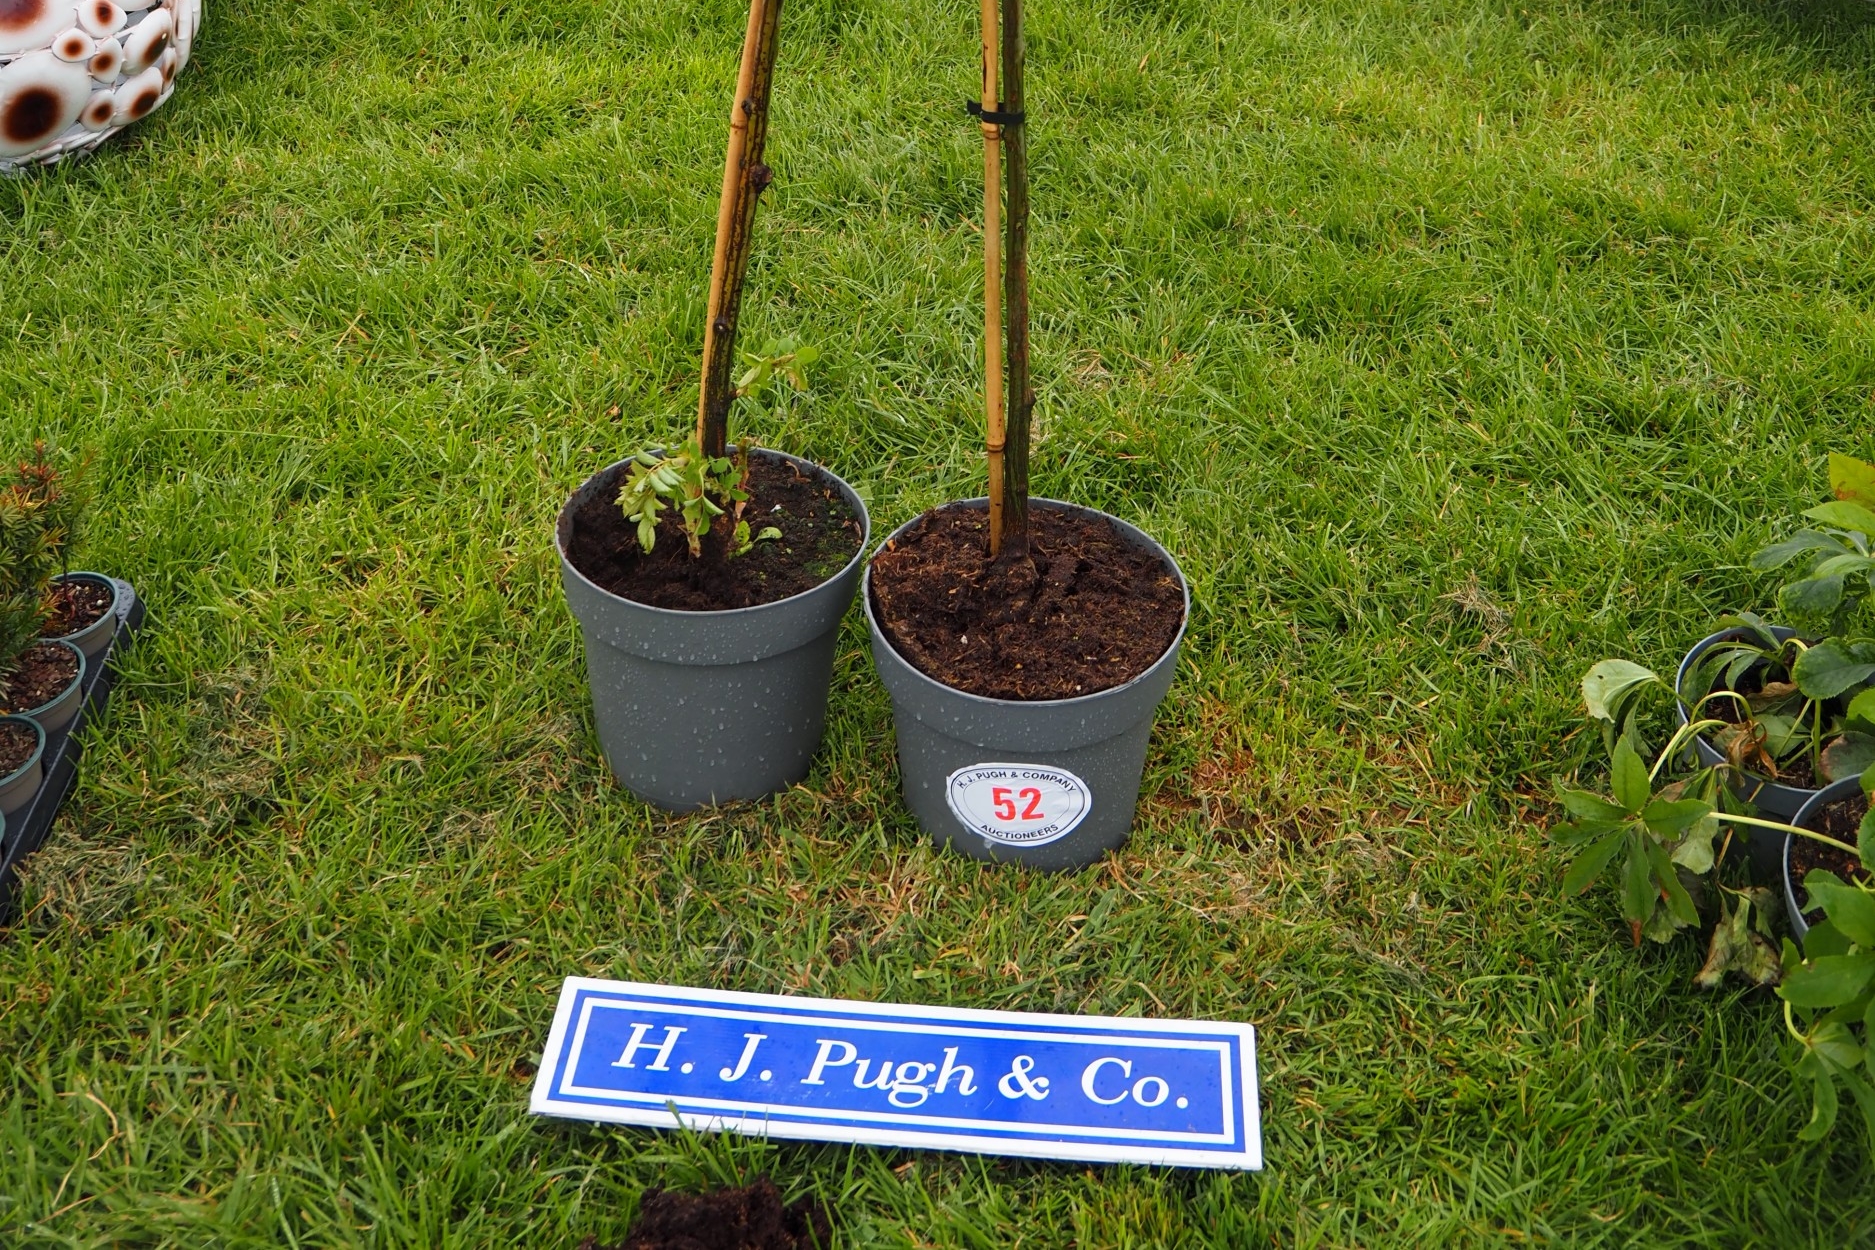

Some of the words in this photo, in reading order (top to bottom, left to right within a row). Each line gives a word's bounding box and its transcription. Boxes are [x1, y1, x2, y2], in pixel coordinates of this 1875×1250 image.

[957, 781, 967, 789] H.
[967, 774, 976, 783] J.
[976, 771, 1007, 780] PUGH
[1022, 771, 1077, 793] COMPANY
[992, 787, 1044, 821] 52
[980, 823, 1059, 840] AUCTIONEERS
[611, 1024, 693, 1074] H.
[719, 1034, 773, 1083] J.
[801, 1039, 978, 1108] Pugh
[998, 1055, 1050, 1101] &
[1081, 1057, 1189, 1109] Co.
